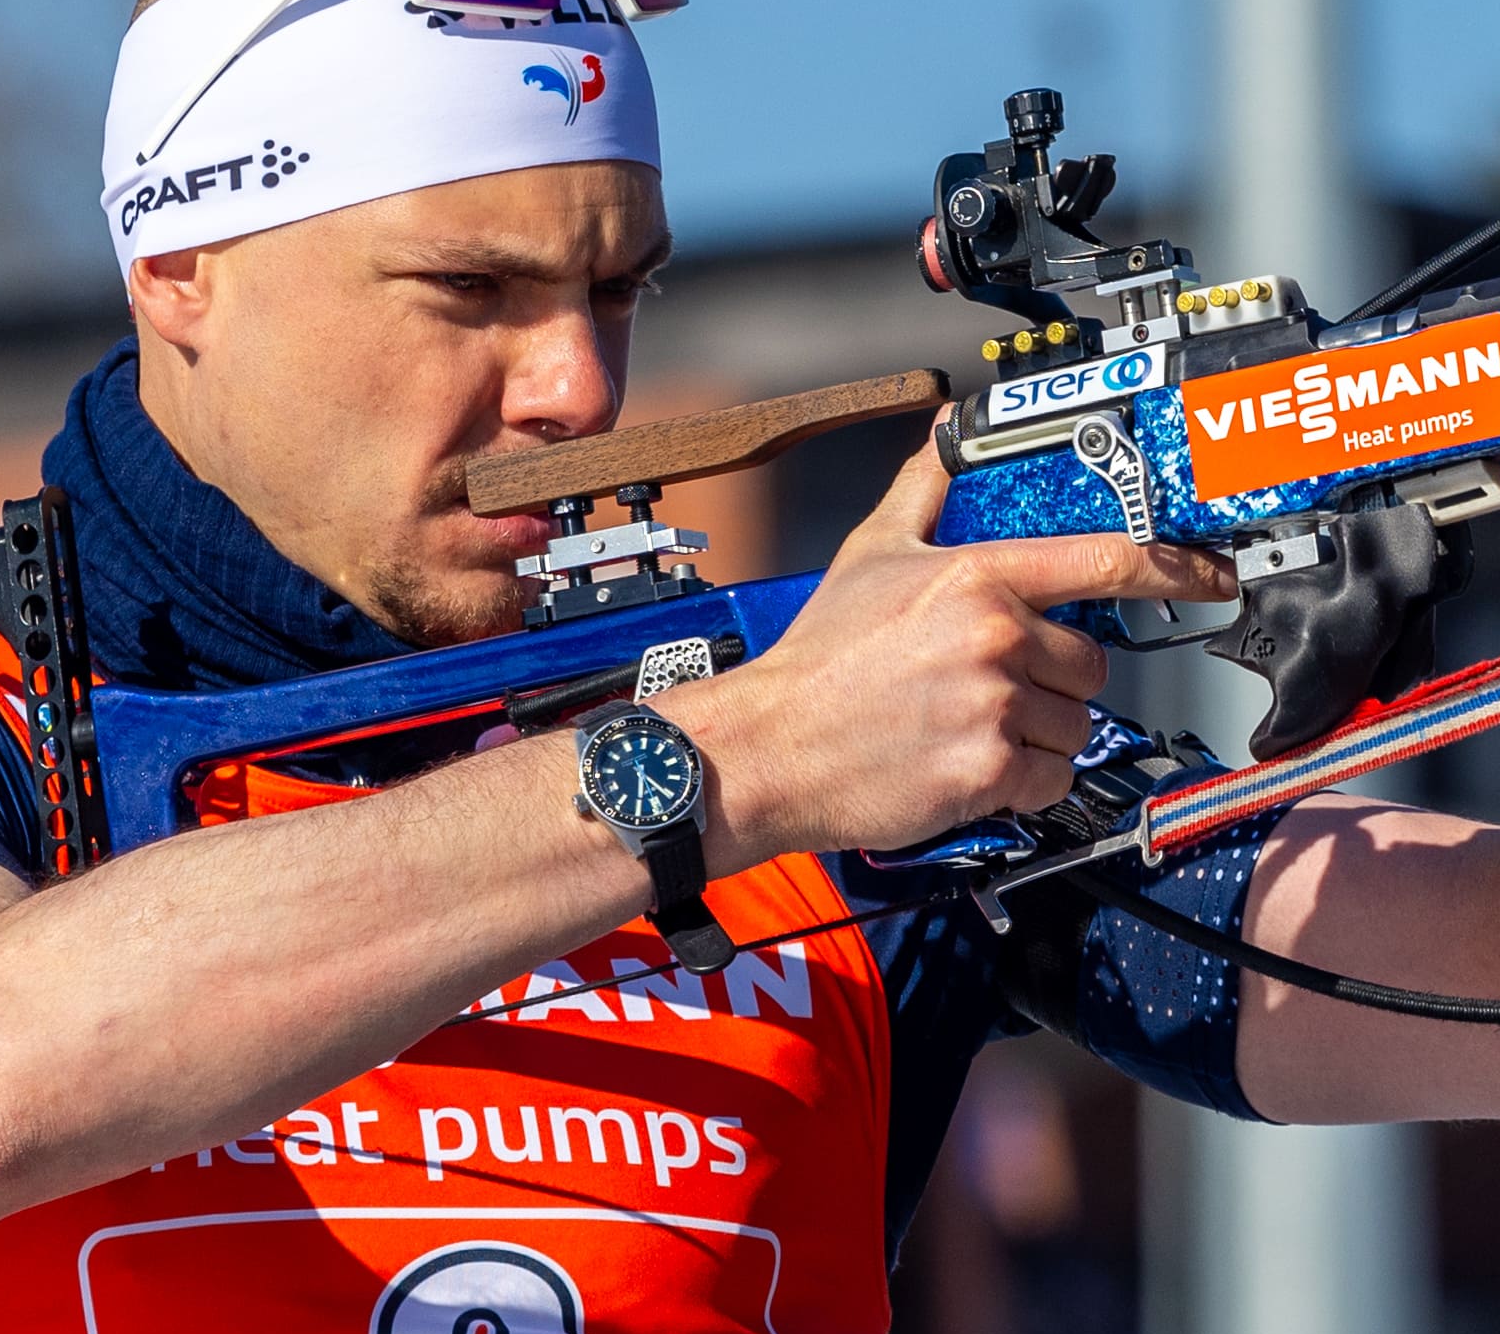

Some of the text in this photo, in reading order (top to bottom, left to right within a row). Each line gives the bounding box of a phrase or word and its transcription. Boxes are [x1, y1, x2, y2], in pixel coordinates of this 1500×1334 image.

[122, 155, 253, 236] CRAFT
[1343, 409, 1473, 452] Heat pumps
[419, 1104, 747, 1187] pumps
